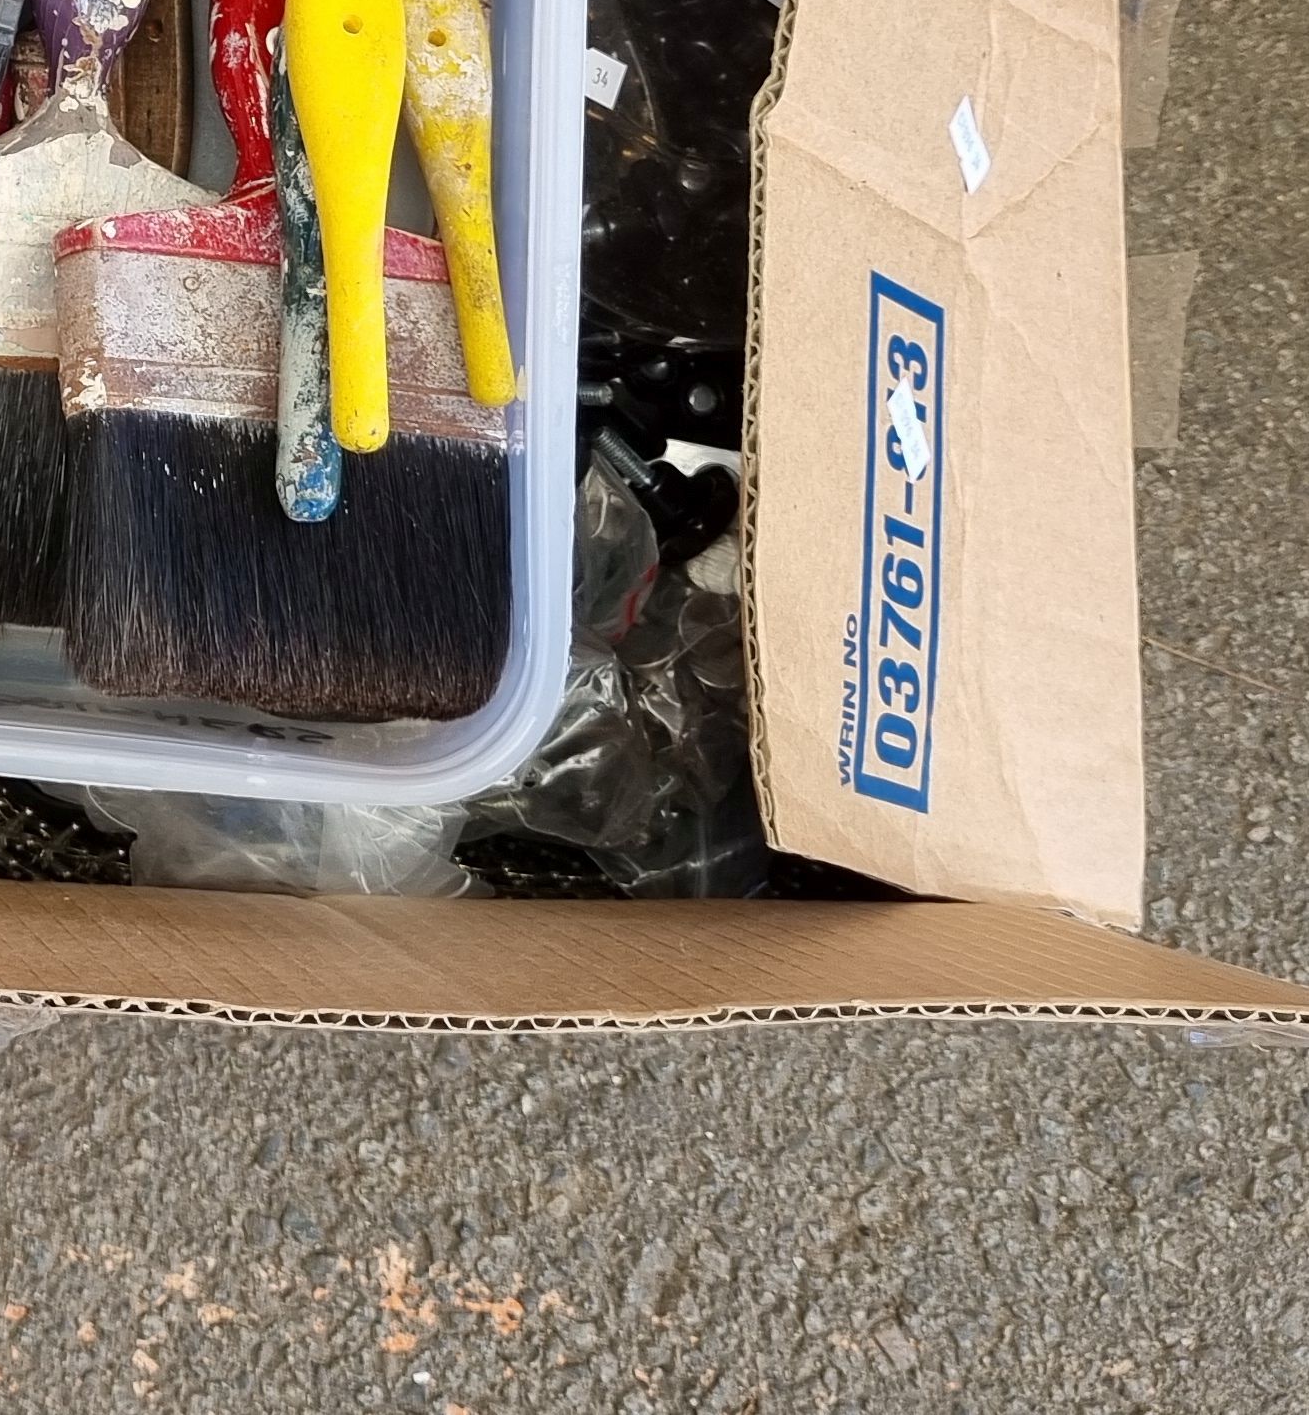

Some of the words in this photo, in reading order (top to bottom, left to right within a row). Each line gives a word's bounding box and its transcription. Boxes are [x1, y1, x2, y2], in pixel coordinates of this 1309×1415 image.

[591, 67, 609, 88] 34
[846, 612, 859, 668] NO
[841, 677, 858, 785] WRIN
